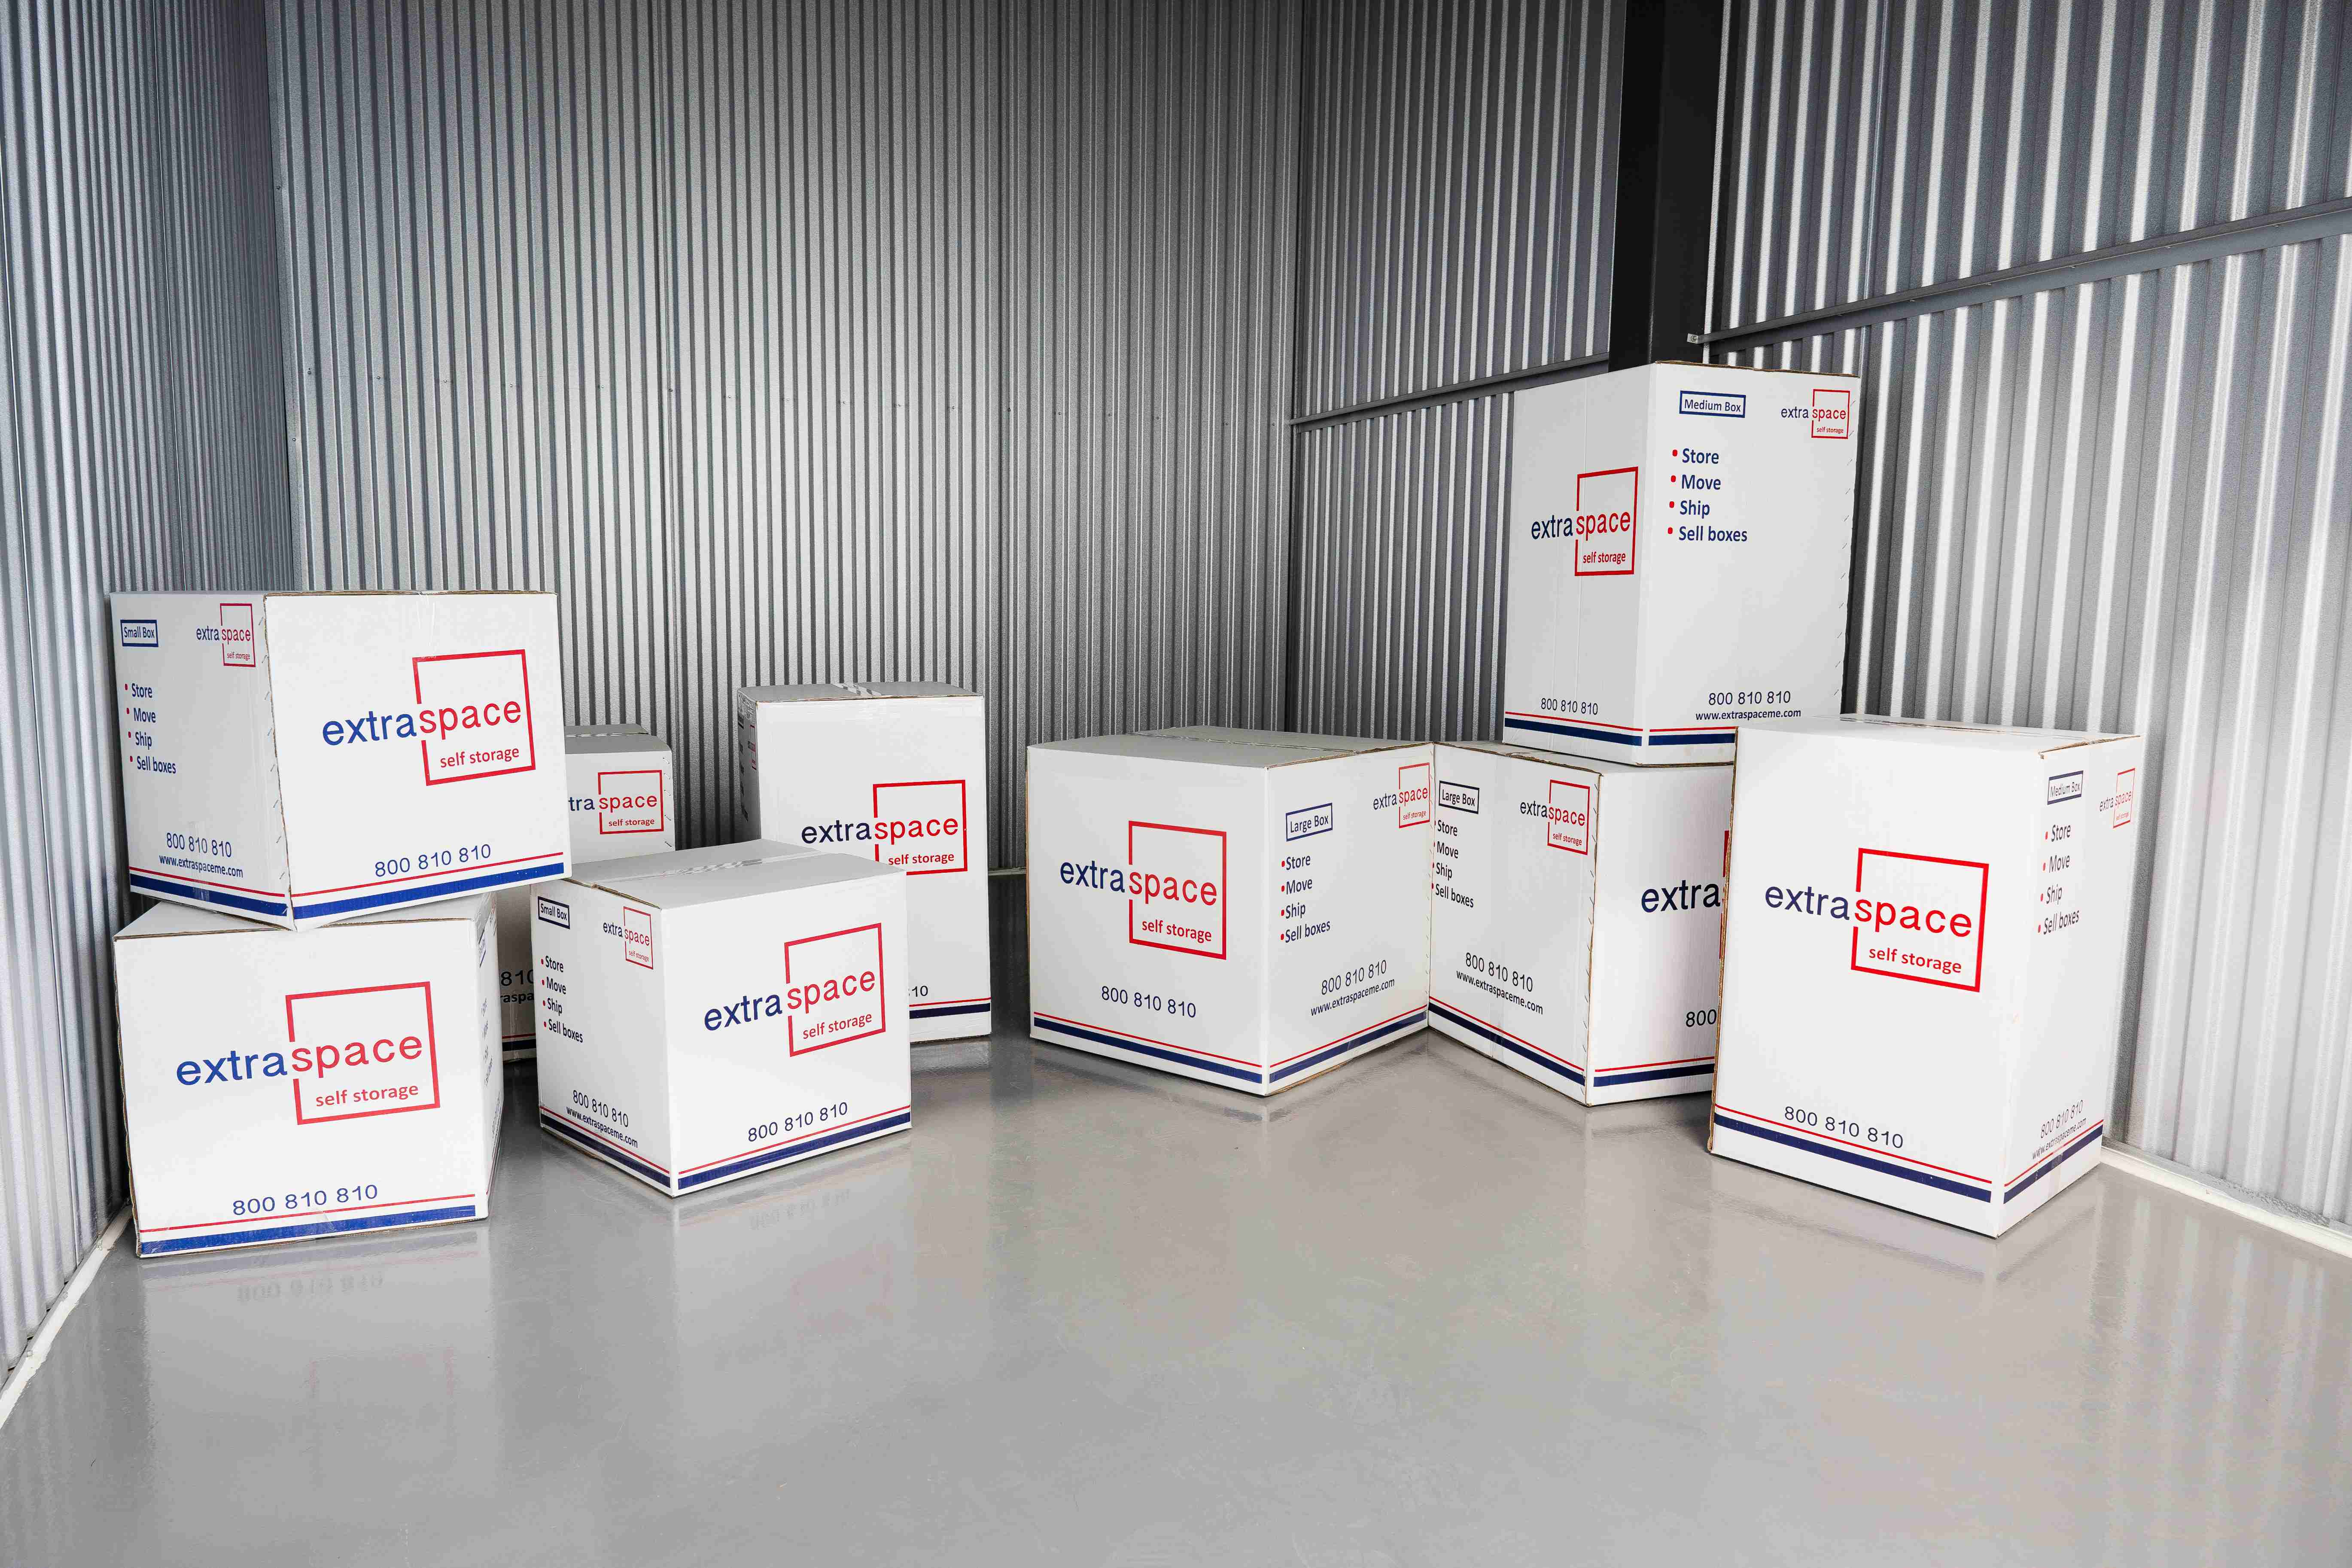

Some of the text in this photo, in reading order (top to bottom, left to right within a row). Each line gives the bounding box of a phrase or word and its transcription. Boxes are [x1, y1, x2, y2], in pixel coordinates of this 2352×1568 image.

[1685, 399, 1740, 412] Medium Box
[1683, 448, 1719, 464] Store
[1682, 475, 1721, 490] Move
[1680, 500, 1710, 519] Ship
[1679, 526, 1747, 542] Sell boxes
[1583, 551, 1625, 564] self storage
[124, 627, 155, 638] Small Box
[132, 683, 152, 698] Store
[1709, 691, 1790, 705] 800 810 810
[134, 708, 155, 723] Move
[1541, 698, 1597, 715] 800 810 810
[1696, 709, 1801, 720] www.extraspaceme.com
[135, 731, 152, 750] Ship
[137, 756, 176, 773] Sell boxes
[441, 749, 519, 767] self storage
[1442, 789, 1475, 806] Large Box
[2051, 786, 2070, 796] Medium
[568, 797, 595, 811] tra
[1290, 816, 1328, 833] Large Box
[1438, 820, 1457, 836] Store
[2051, 825, 2071, 842] Store
[167, 833, 231, 857] 800 810 810
[1437, 841, 1458, 859] Move
[1563, 836, 1582, 846] storage
[159, 856, 243, 877] www.extraspaceme.com
[375, 844, 490, 877] 800 810 810
[888, 854, 954, 865] self storage
[1287, 856, 1310, 870] Store
[2049, 855, 2069, 873] Move
[1436, 862, 1452, 880] Ship
[1287, 880, 1312, 895] Move
[1436, 884, 1473, 907] Sell boxes
[2046, 884, 2062, 904] Ship
[541, 903, 567, 920] Small Box
[1286, 902, 1305, 919] Ship
[1142, 919, 1211, 943] self storage
[2044, 910, 2079, 935] Sell boxes
[1285, 921, 1330, 943] Sell boxes
[545, 956, 563, 972] Store
[1869, 948, 1961, 974] self storage
[1322, 960, 1386, 995] 800 810 810
[1466, 953, 1533, 992] 800 810 810
[547, 977, 566, 994] Move
[909, 986, 928, 997] 10
[1457, 970, 1543, 1014] www.extraspaceme.com
[1102, 986, 1196, 1017] 800 810 810
[1311, 978, 1394, 1016] www.extraspaceme.com
[548, 998, 562, 1016] Ship
[803, 1014, 871, 1039] self storage
[1686, 1009, 1716, 1027] 800
[548, 1019, 583, 1043] Sell boxes
[316, 1086, 418, 1106] self storage
[573, 1090, 628, 1127] 800 810 810
[566, 1107, 637, 1148] www.extraspaceme.com
[749, 1102, 847, 1142] 800 810 810
[1785, 1107, 1903, 1148] 800 810 810
[2041, 1100, 2083, 1138] 800 810 810
[233, 1185, 377, 1215] 800 810 810
